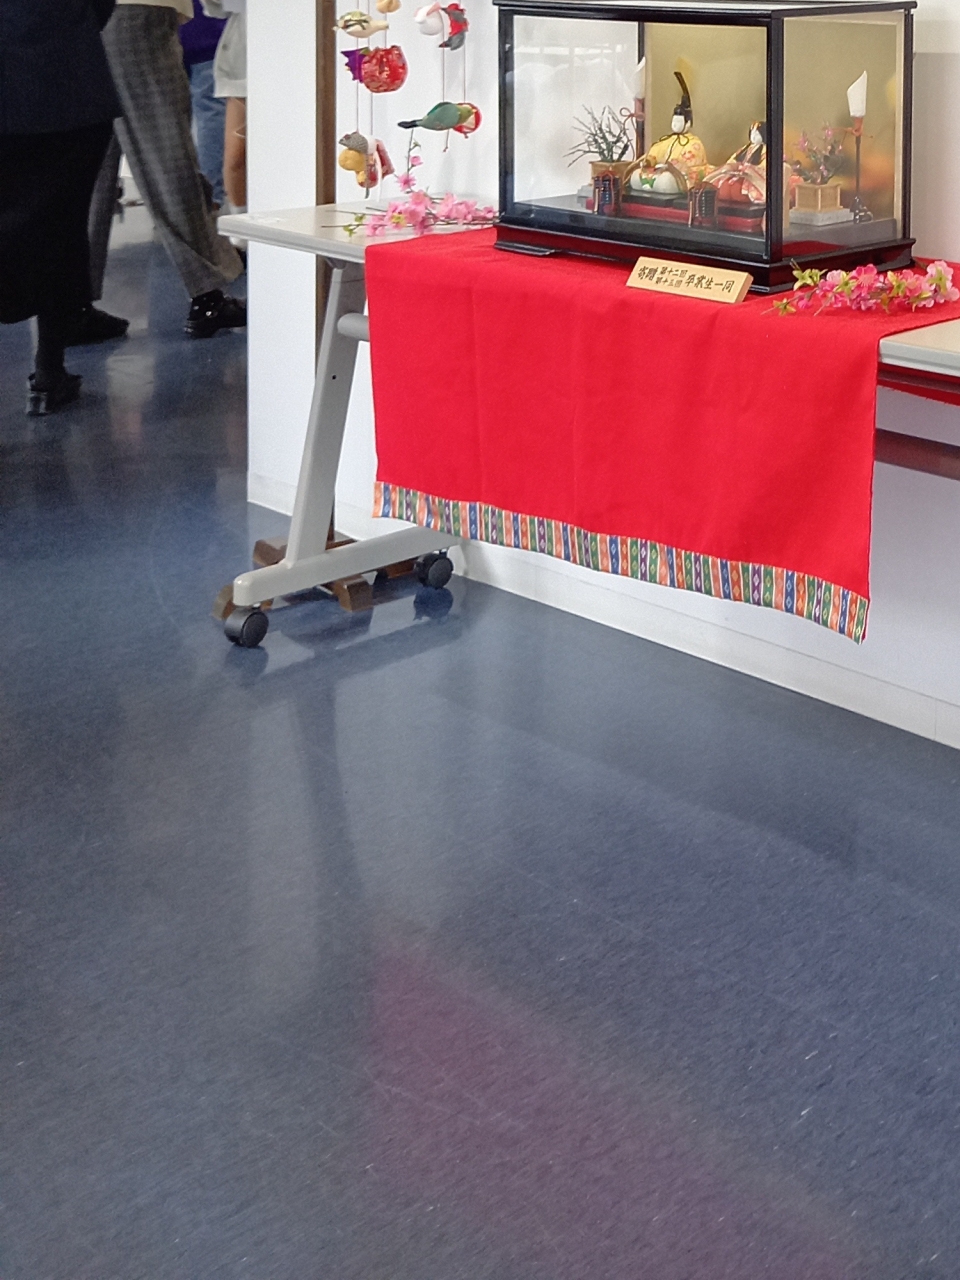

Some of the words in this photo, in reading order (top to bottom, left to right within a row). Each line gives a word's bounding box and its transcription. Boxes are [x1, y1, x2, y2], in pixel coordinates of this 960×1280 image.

[638, 265, 658, 281] 寄贈
[685, 274, 735, 293] 卒業生一同
